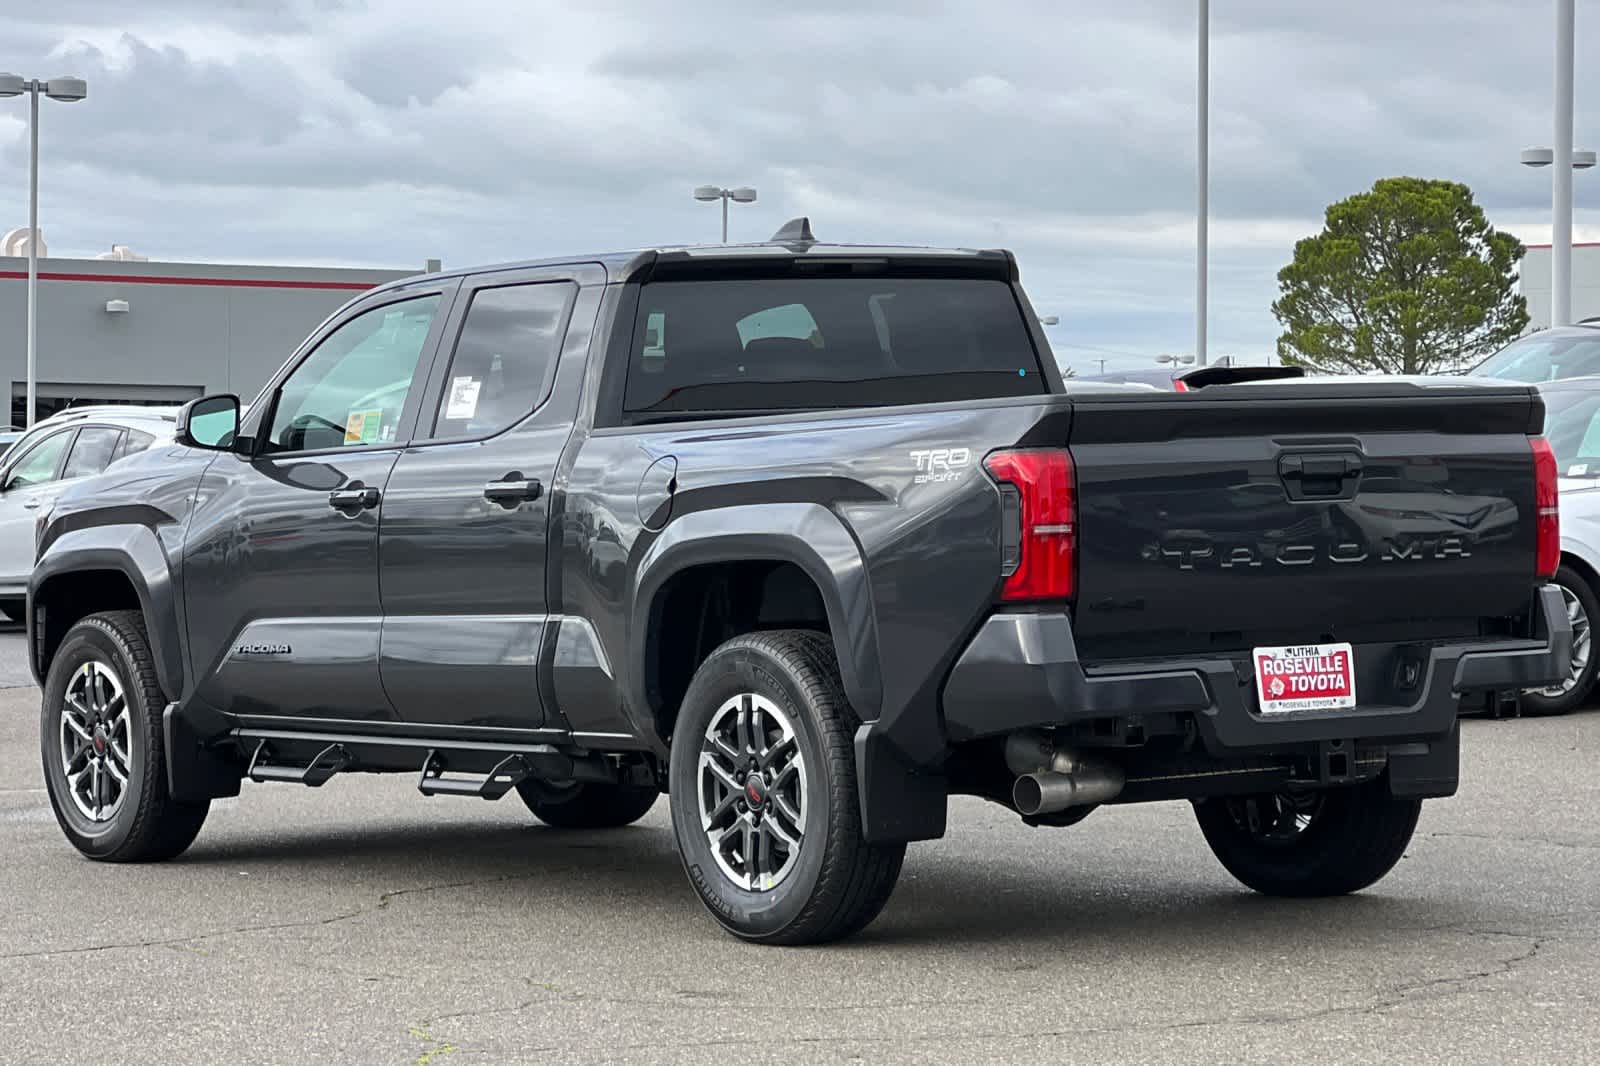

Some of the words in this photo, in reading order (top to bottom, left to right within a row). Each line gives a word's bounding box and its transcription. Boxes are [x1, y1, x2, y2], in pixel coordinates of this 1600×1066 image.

[909, 447, 970, 472] TRD
[914, 471, 962, 484] SPORT
[1160, 537, 1472, 570] TACOMA
[233, 644, 292, 655] TACOMA
[1293, 646, 1320, 657] LITHIA
[1262, 656, 1343, 675] ROSEVILLE
[1289, 674, 1345, 692] TOYOTA
